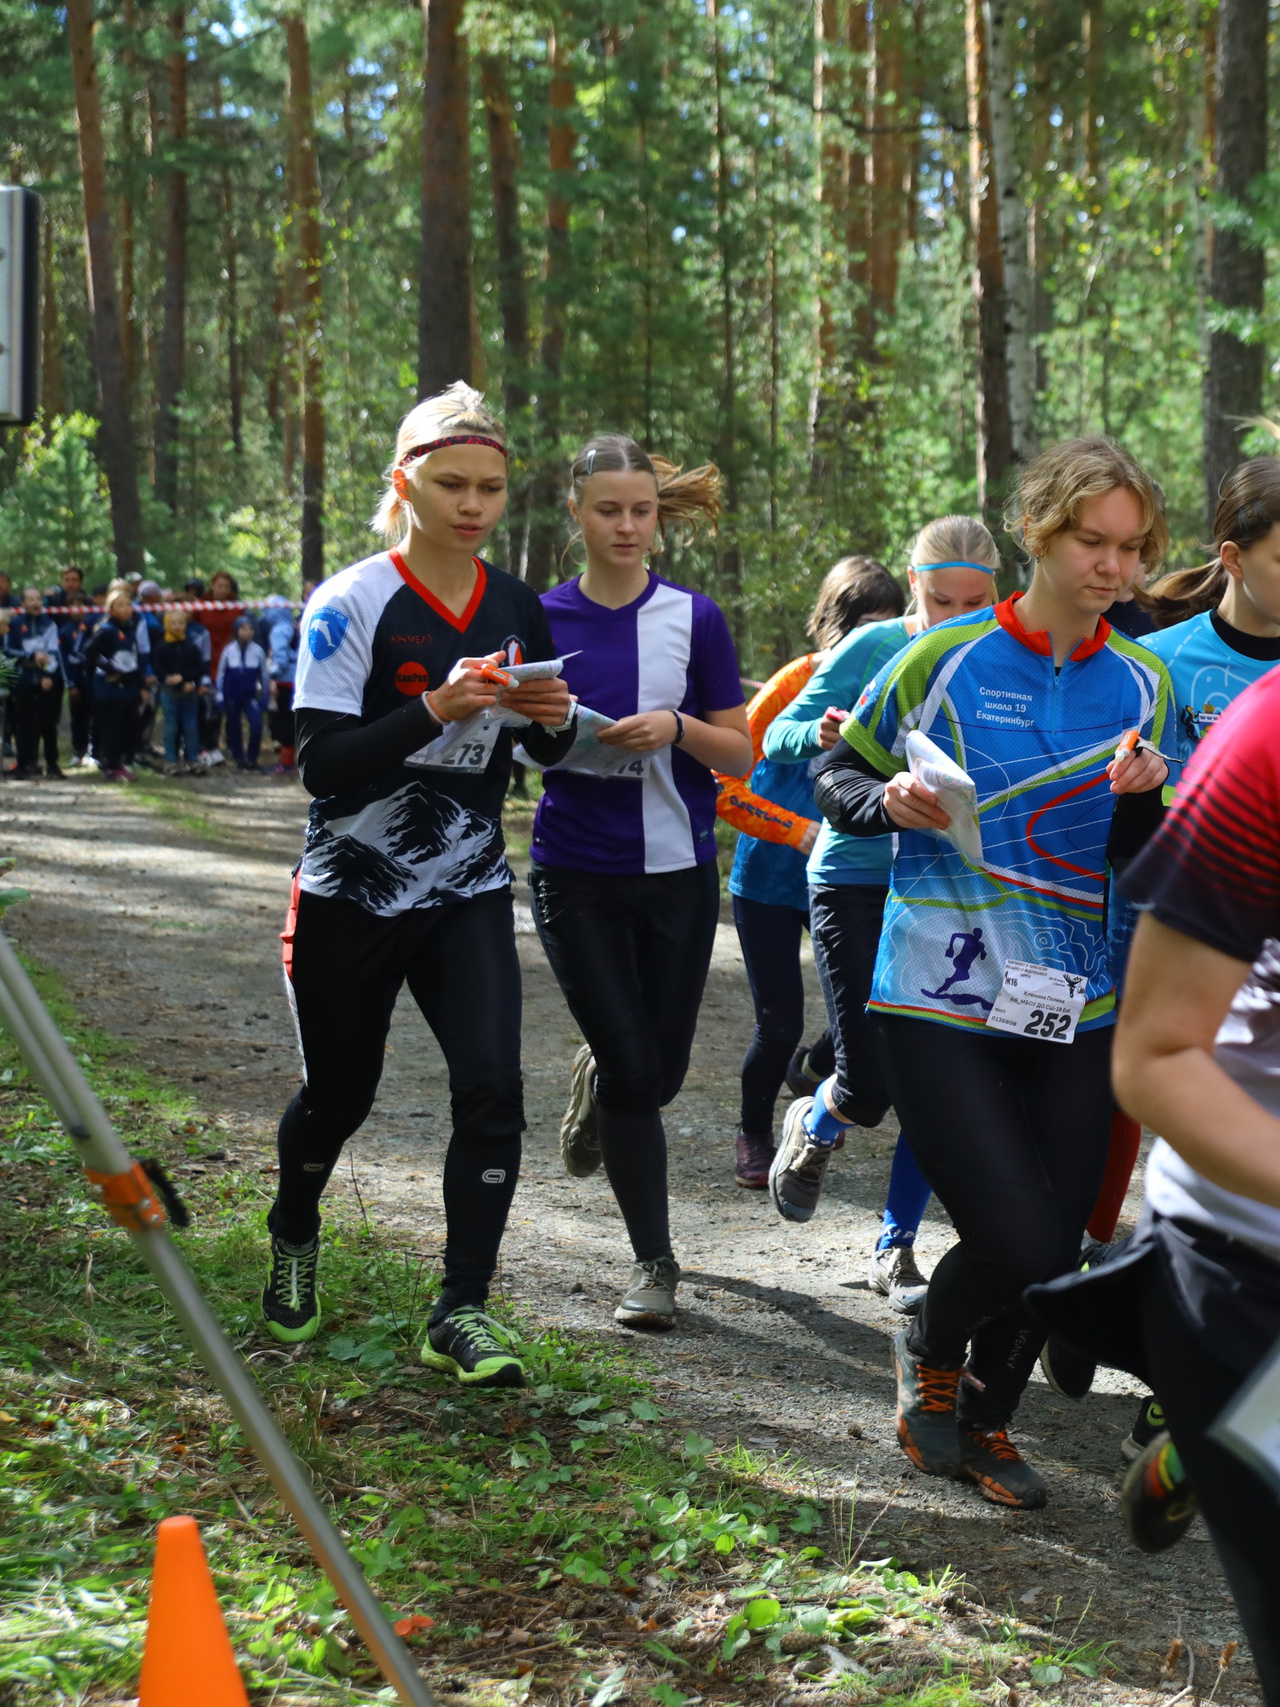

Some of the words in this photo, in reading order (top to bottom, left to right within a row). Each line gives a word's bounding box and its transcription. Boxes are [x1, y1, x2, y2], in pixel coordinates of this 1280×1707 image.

[980, 687, 1033, 701] Спортивная
[985, 702, 1012, 711] школа
[1015, 704, 1027, 713] 19
[976, 710, 1035, 727] Екатеринбург
[1023, 1009, 1072, 1040] 252
